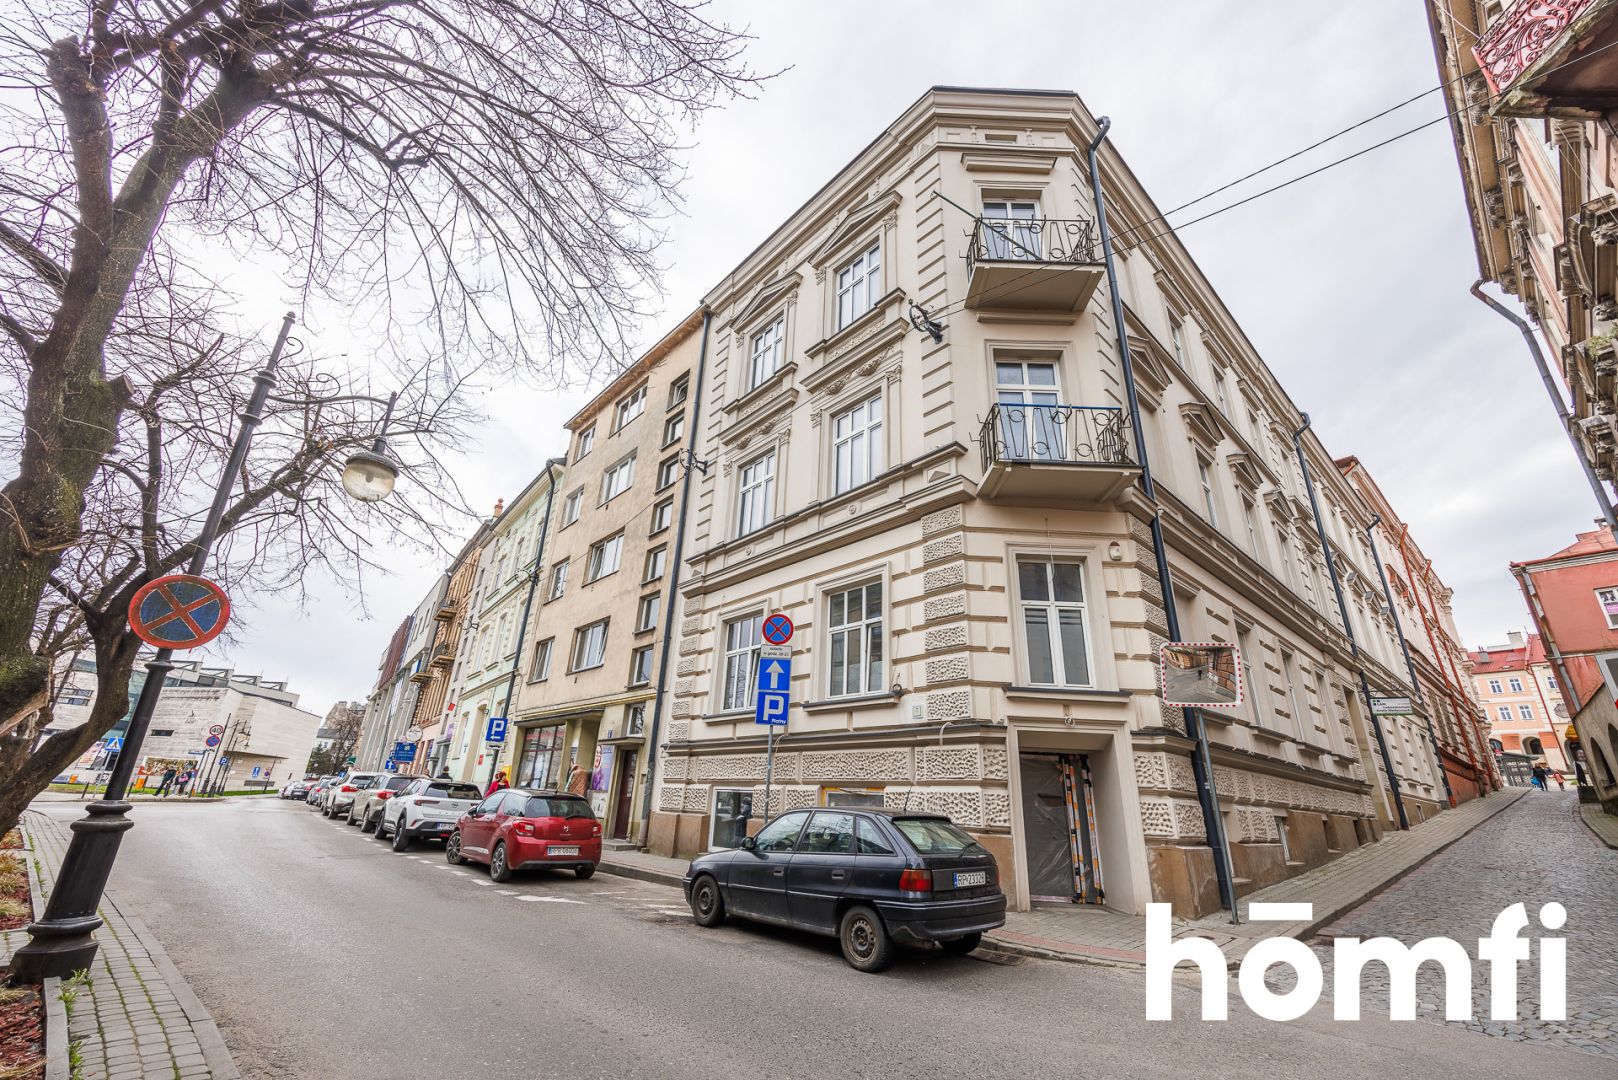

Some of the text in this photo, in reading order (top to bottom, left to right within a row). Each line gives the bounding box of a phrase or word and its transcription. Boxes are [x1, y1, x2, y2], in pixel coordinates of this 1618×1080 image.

[763, 695, 784, 720] P
[491, 720, 504, 735] P
[957, 874, 967, 885] RP
